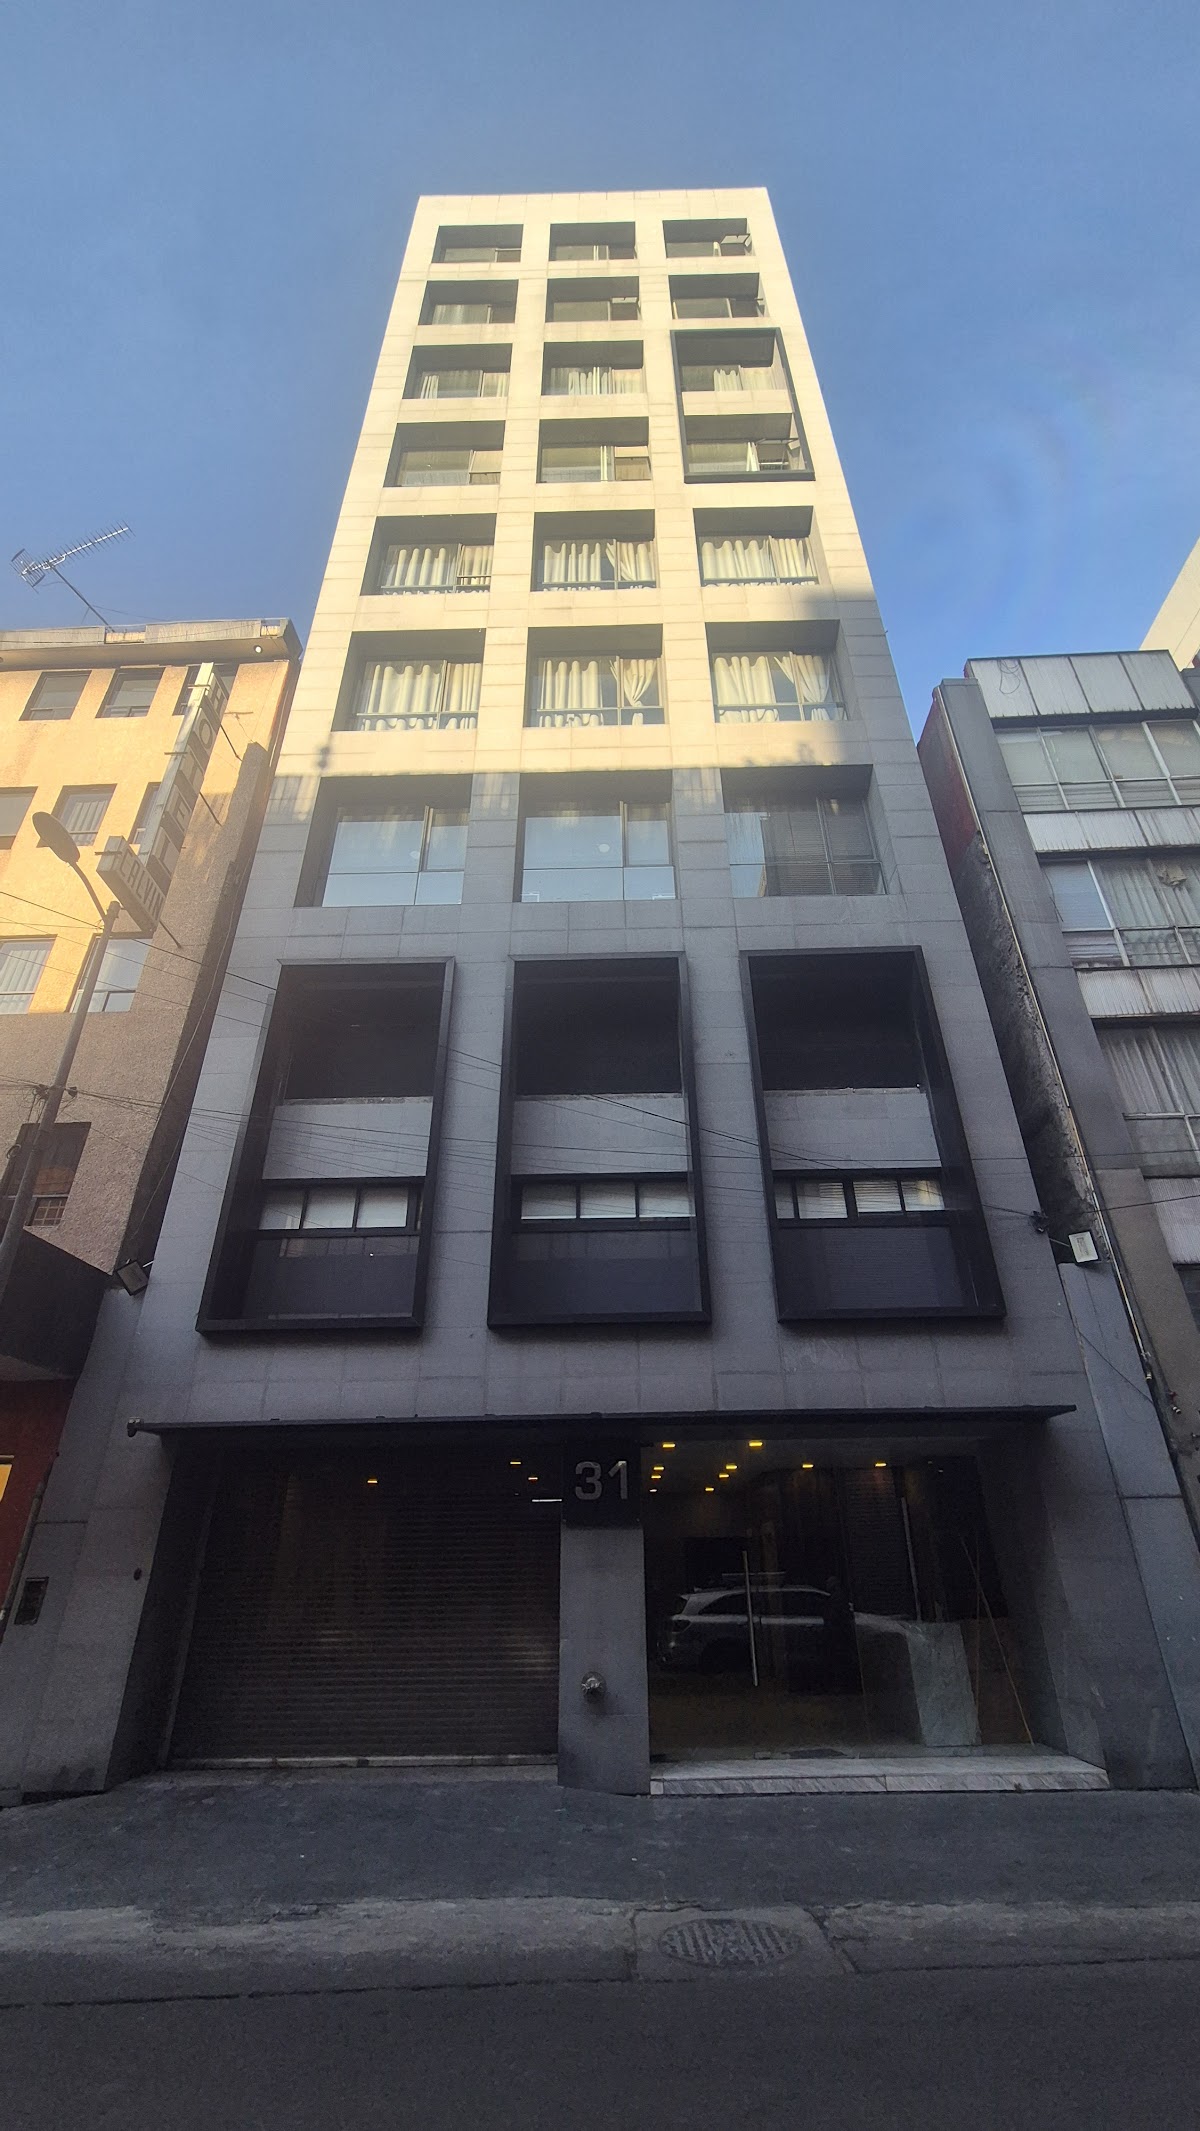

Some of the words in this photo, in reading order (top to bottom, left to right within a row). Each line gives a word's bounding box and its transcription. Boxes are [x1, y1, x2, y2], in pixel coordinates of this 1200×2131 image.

[158, 680, 226, 878] HOTEL
[119, 848, 165, 923] CALVIN
[575, 1460, 628, 1500] 31
